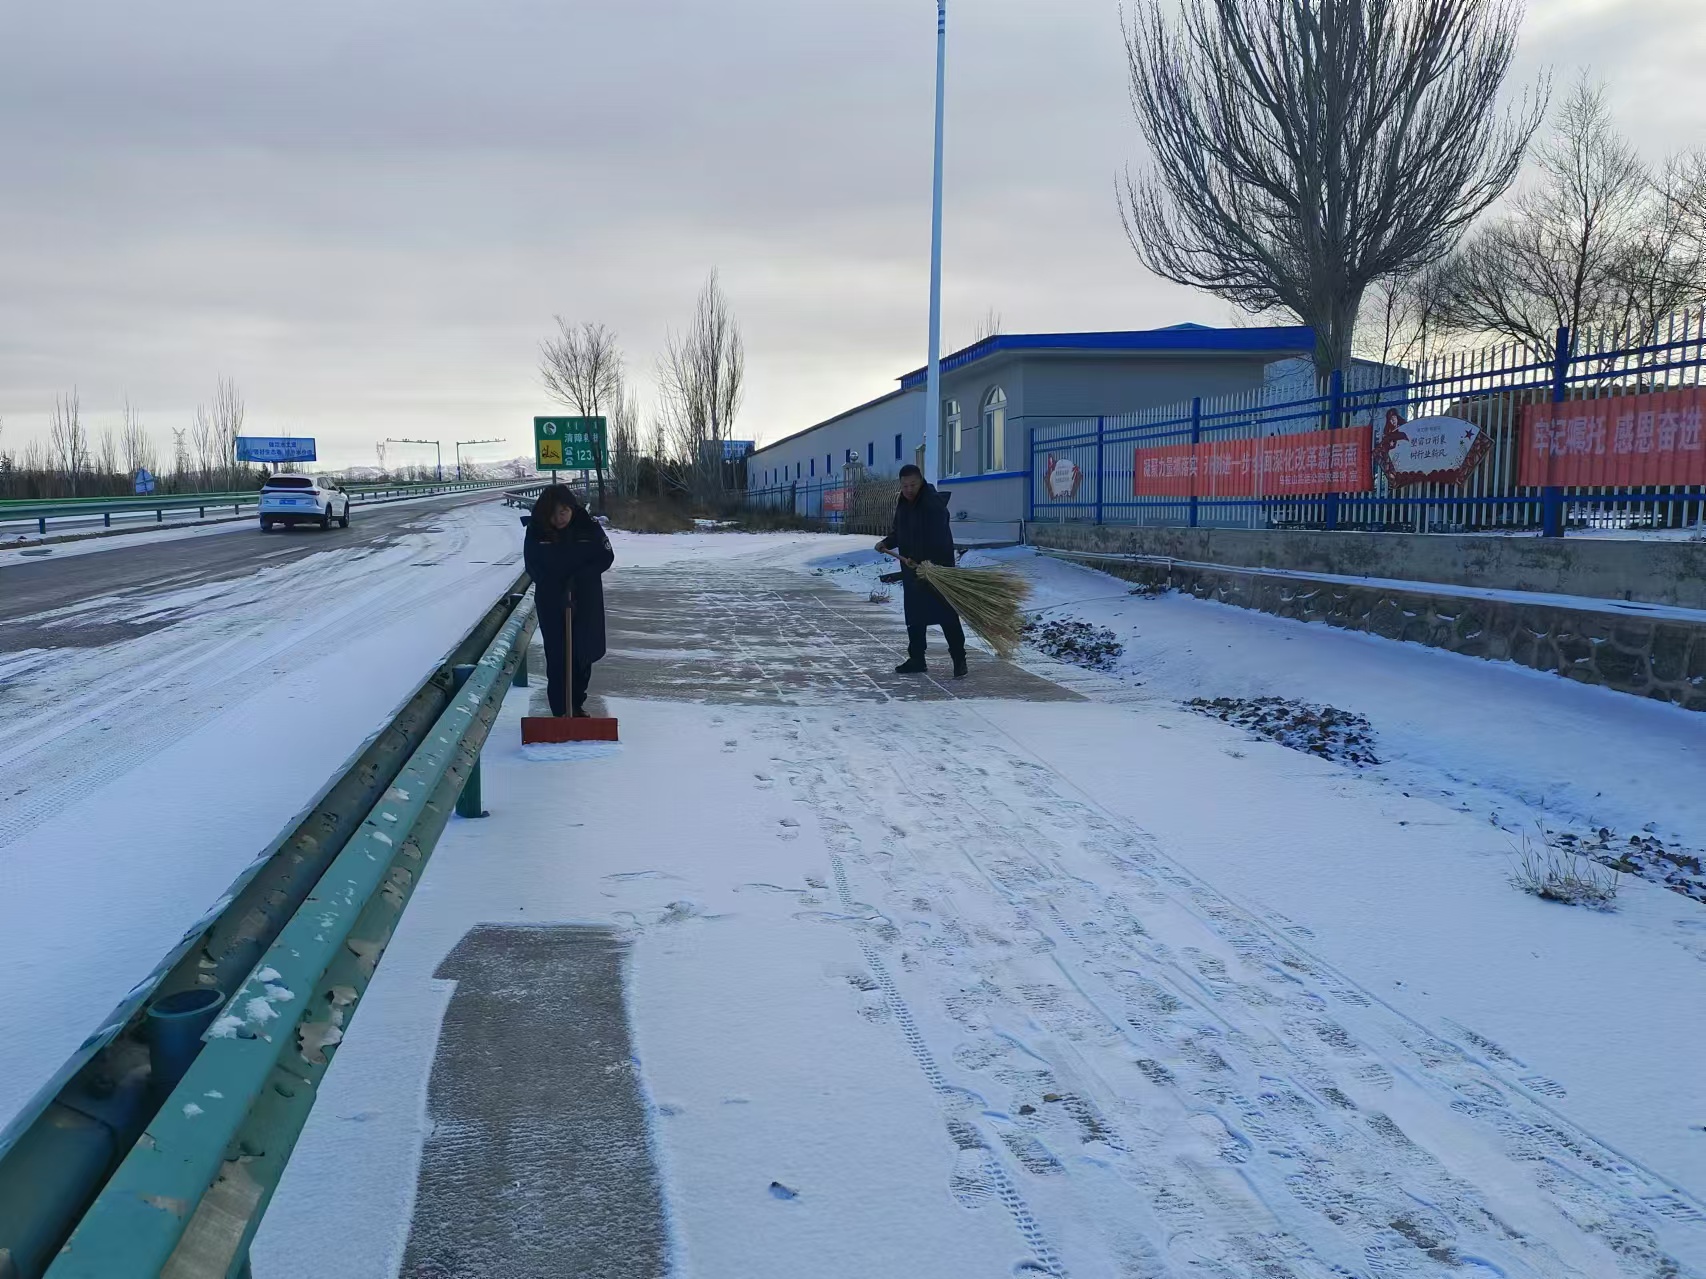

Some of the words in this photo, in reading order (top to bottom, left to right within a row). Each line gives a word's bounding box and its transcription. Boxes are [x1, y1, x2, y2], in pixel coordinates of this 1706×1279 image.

[1533, 416, 1606, 459] 牢记嘱托
[1613, 406, 1702, 454] 感恩奋进
[577, 449, 603, 461] 123
